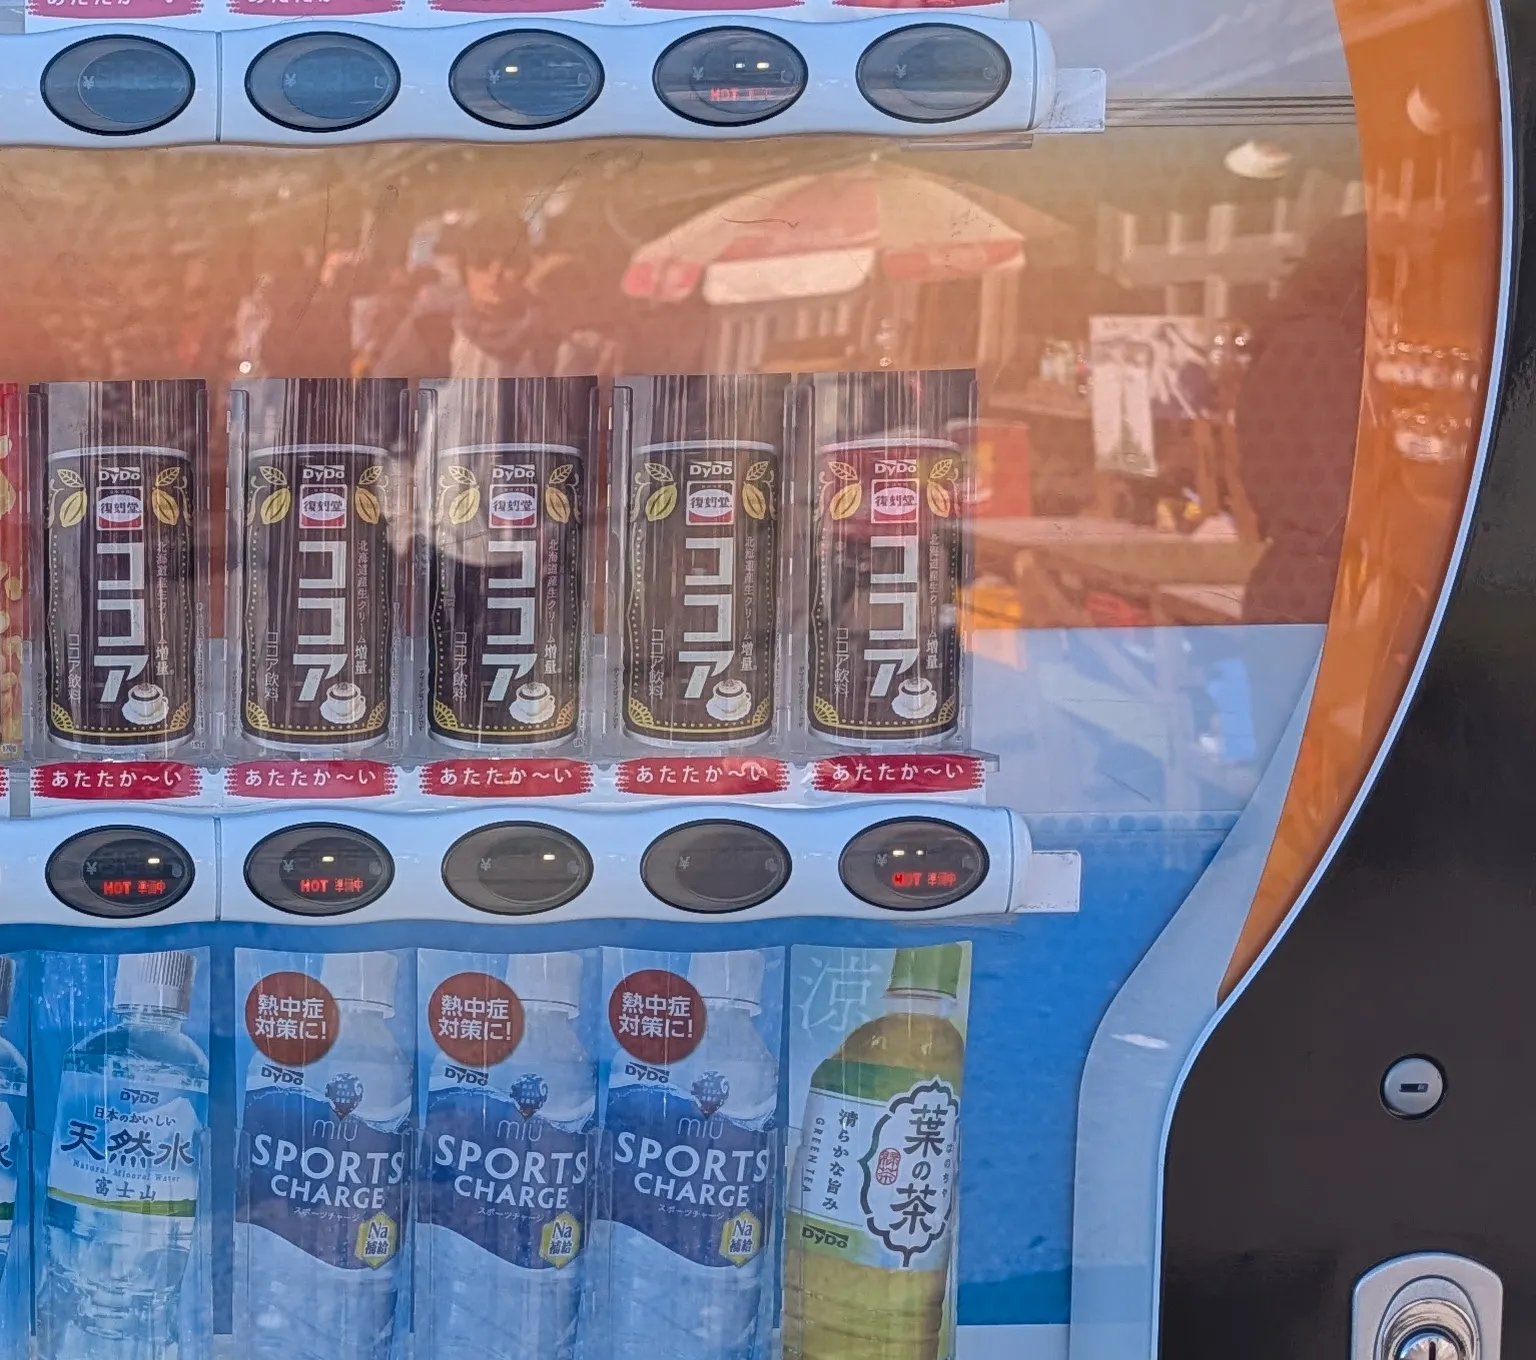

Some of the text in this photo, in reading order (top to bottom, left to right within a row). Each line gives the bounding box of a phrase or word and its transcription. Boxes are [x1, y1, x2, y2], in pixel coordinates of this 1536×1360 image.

[689, 460, 733, 479] DyDo
[94, 542, 150, 703] ココア
[482, 541, 538, 701] ココア
[678, 537, 735, 698] ココア
[864, 536, 919, 697] ココア
[257, 994, 324, 1019] 熱中症
[441, 994, 509, 1019] 熱中症
[622, 992, 691, 1017] 熱中症
[261, 1066, 304, 1086] DyDo
[60, 1119, 195, 1170] 天然水
[252, 1134, 405, 1185] SPORTS
[435, 1134, 587, 1185] SPORTS
[615, 1132, 768, 1184] SPORTS
[454, 1174, 568, 1208] CHARGE
[634, 1172, 749, 1207] CHARGE
[889, 1104, 948, 1235] 葉の茶
[271, 1174, 384, 1209] CHARGE
[801, 1227, 849, 1249] DyDo
